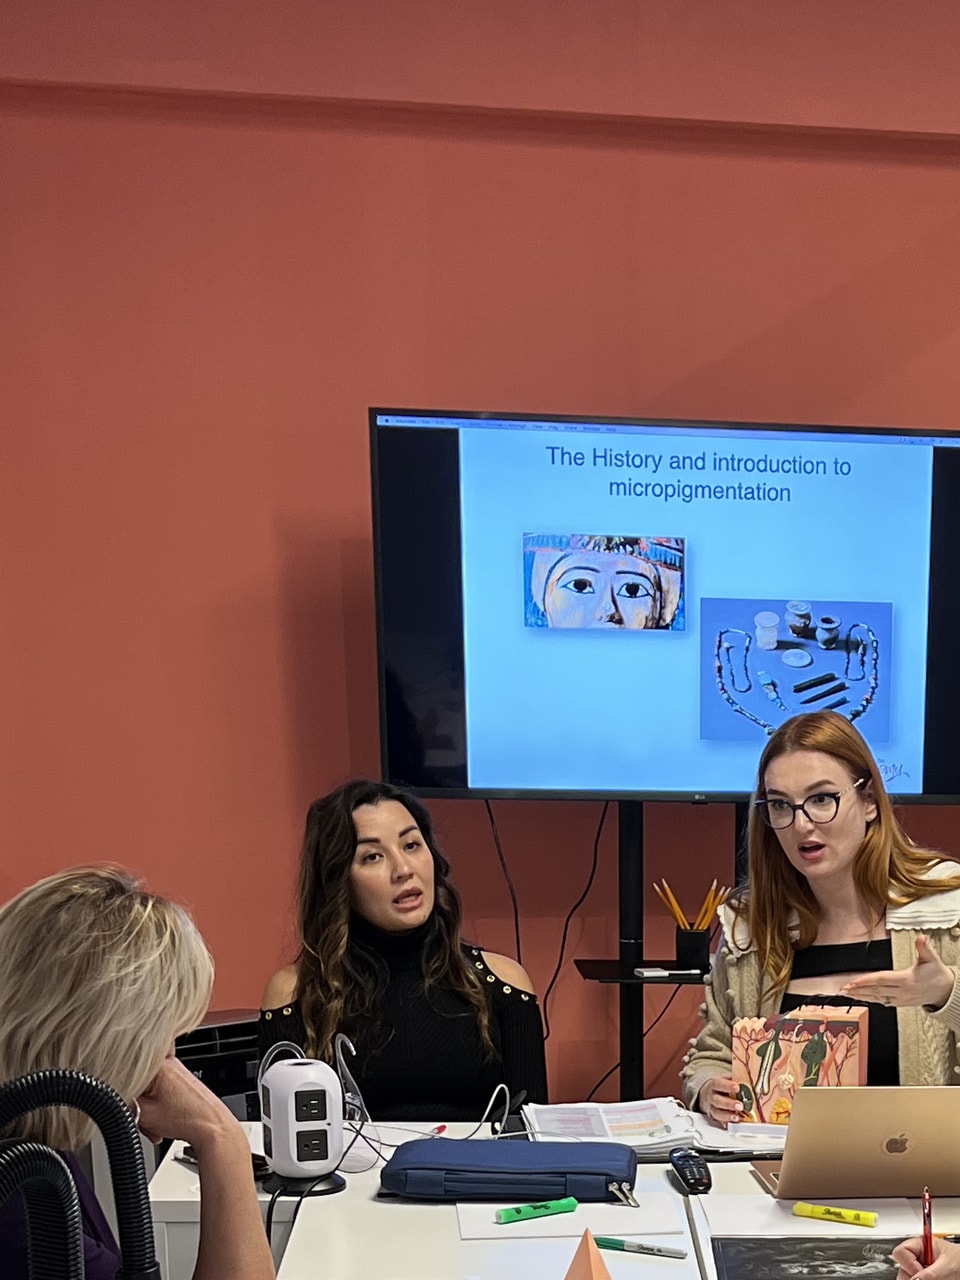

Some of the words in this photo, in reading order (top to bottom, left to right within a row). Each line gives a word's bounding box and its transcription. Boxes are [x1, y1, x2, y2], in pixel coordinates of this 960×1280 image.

[546, 446, 585, 467] The
[592, 448, 663, 474] History
[669, 452, 706, 471] and
[712, 452, 827, 475] introduction
[833, 456, 852, 476] to
[608, 478, 791, 503] micropigmentation
